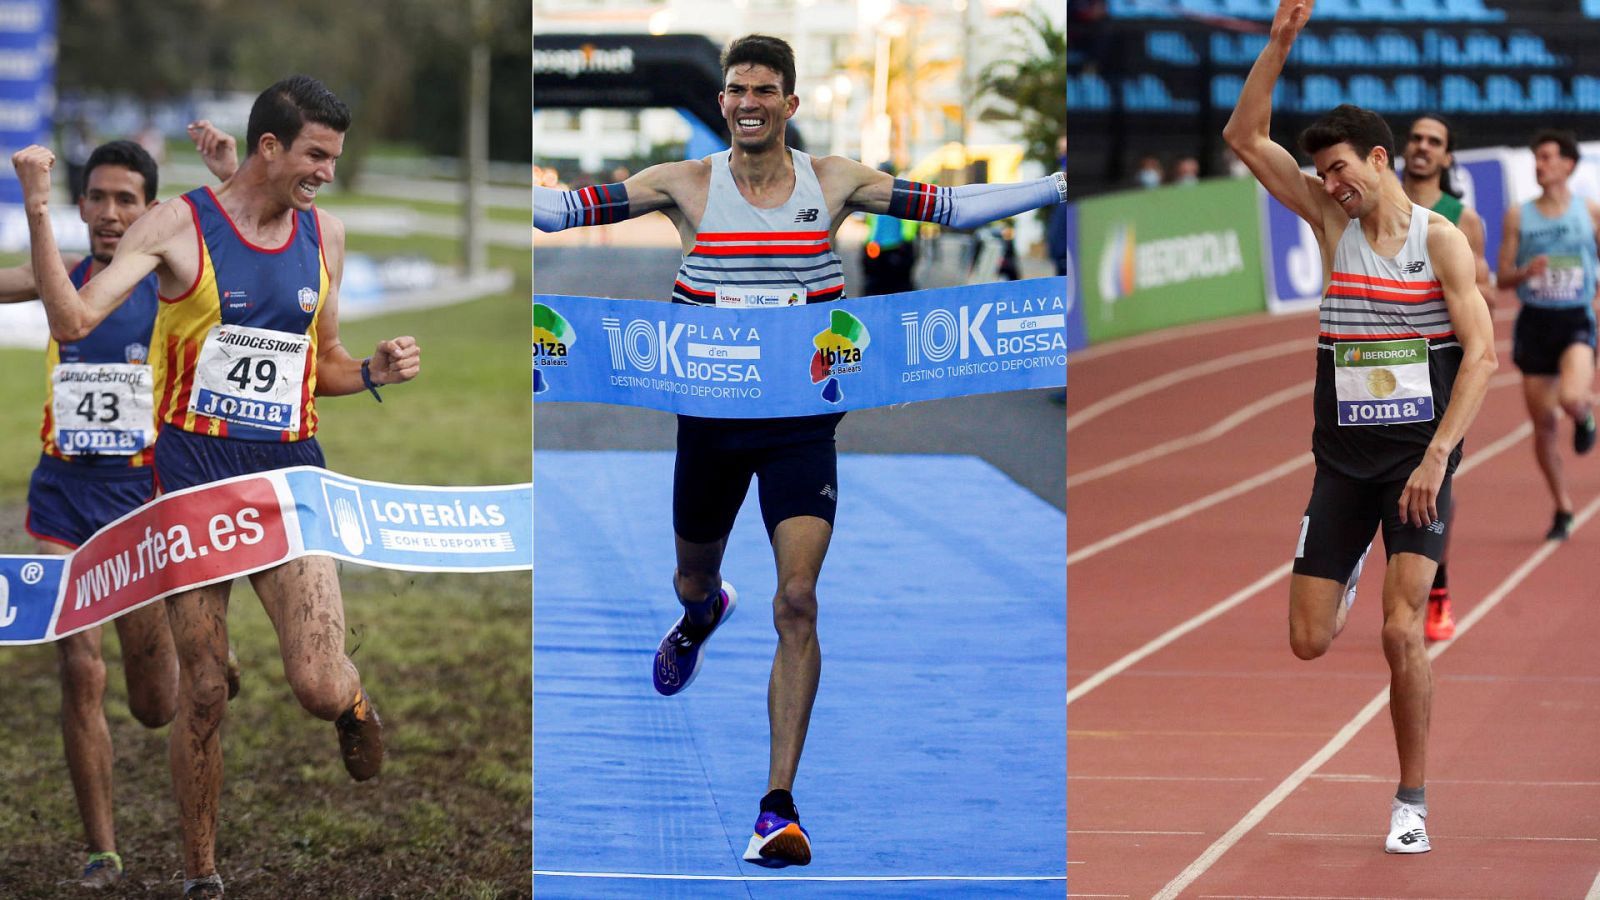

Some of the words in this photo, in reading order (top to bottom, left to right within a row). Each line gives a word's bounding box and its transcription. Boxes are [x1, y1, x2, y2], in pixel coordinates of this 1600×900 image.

[996, 296, 1064, 315] PLAYA
[687, 324, 760, 341] PLAYA
[901, 303, 994, 366] 10K
[1020, 320, 1037, 330] d'en
[216, 330, 303, 354] BRIDGESTONE
[602, 318, 685, 378] 10K
[708, 347, 728, 358] d'en
[997, 332, 1067, 355] BOSSA
[820, 345, 861, 366] Ibiza
[1362, 348, 1417, 360] IBERDROLA
[227, 357, 277, 393] 49
[687, 361, 762, 382] BOSSA
[902, 368, 944, 383] DESTINO
[947, 361, 998, 378] TURÍSTICO
[1001, 355, 1067, 372] DEPORTIVO
[610, 375, 649, 389] DESTINO
[651, 378, 688, 395] TURÍSTICO
[690, 386, 762, 399] DEPORTIVO
[76, 392, 119, 423] 43
[371, 499, 506, 528] LOTERÍAS
[395, 536, 419, 546] CON
[425, 538, 436, 547] EL
[440, 538, 497, 548] DEPORTE
[73, 506, 265, 611] www.rfea.es
